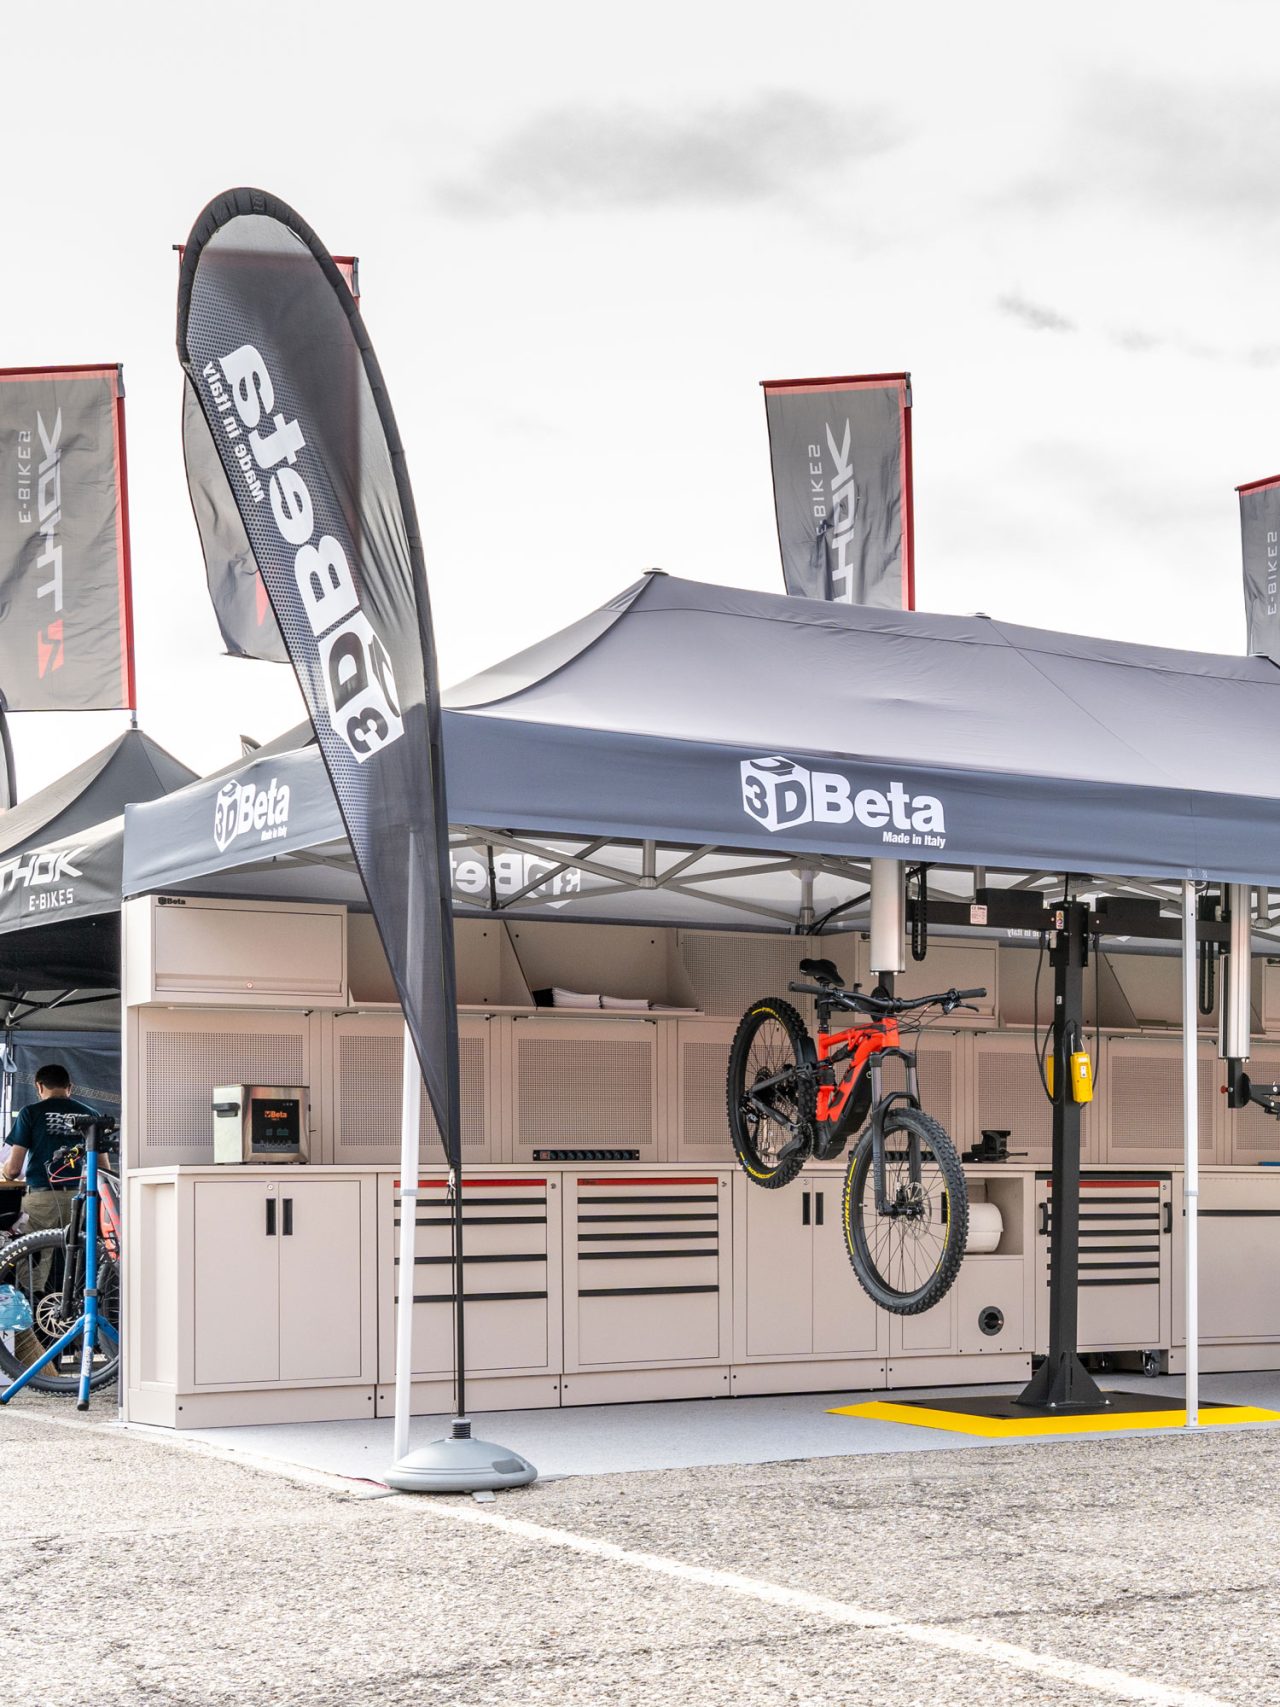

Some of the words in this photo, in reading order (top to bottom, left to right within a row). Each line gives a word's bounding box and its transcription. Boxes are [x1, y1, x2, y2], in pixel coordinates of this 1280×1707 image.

[882, 831, 910, 845] Made
[912, 833, 922, 846] in
[924, 834, 946, 849] Italy
[29, 888, 74, 912] E-BIKES
